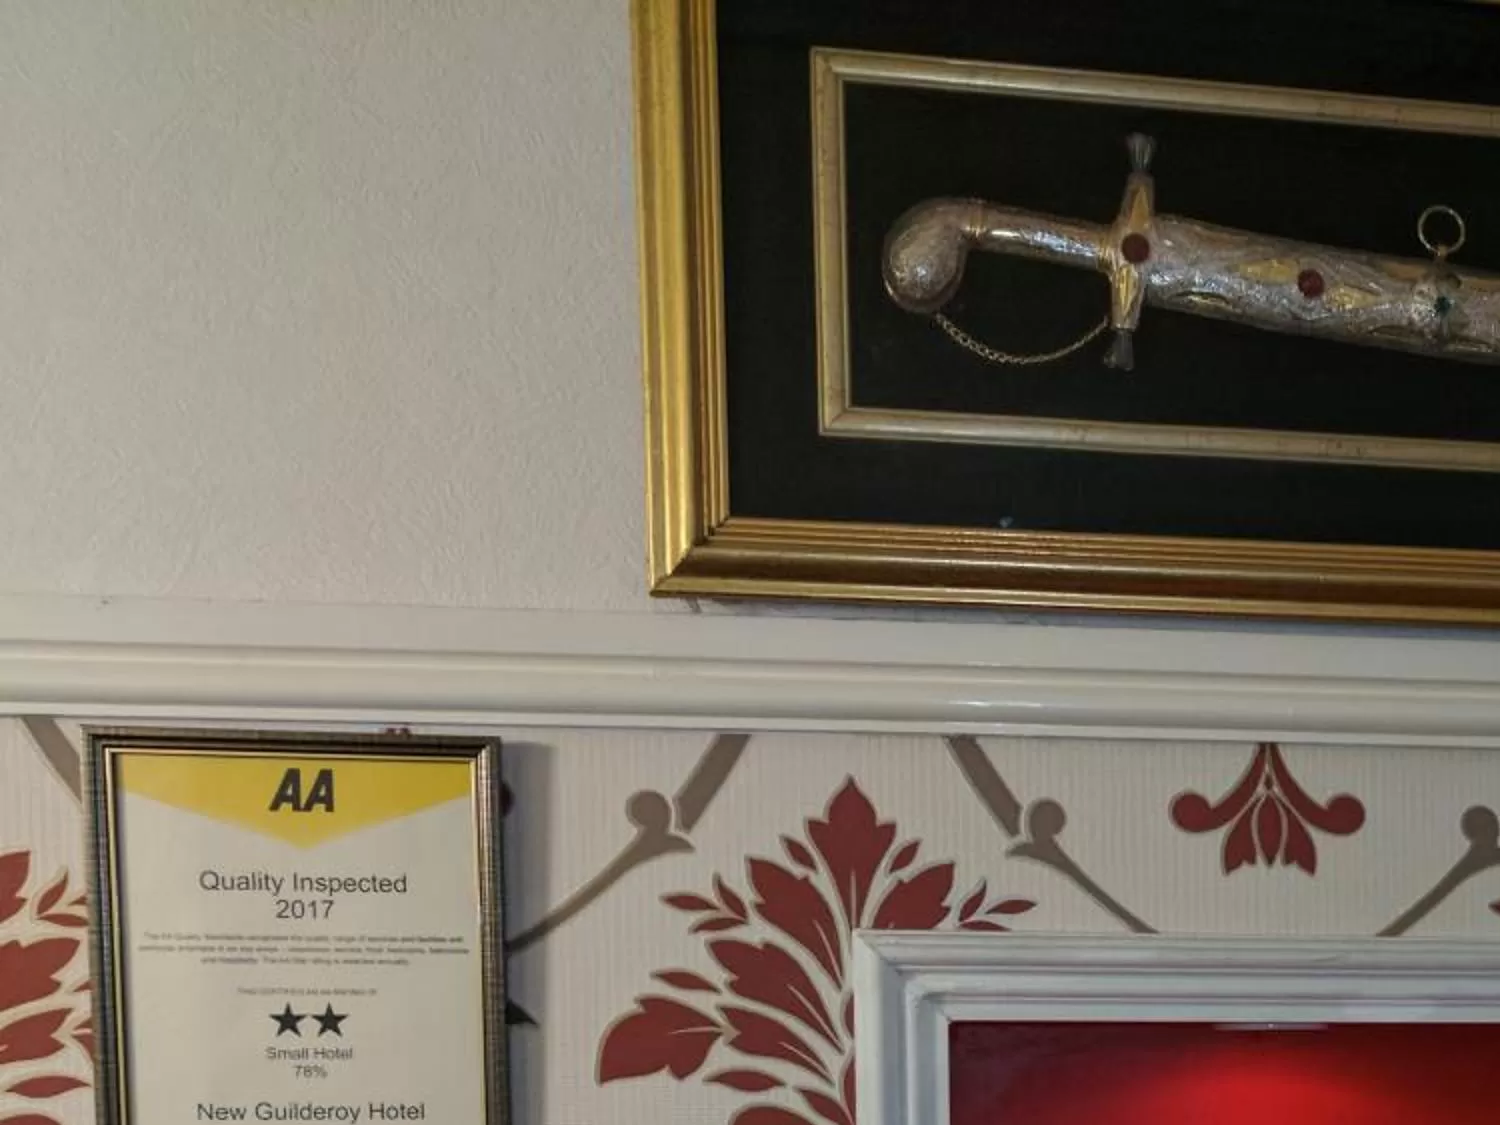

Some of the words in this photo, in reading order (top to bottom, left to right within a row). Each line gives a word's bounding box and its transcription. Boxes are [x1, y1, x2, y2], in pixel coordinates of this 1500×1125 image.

[268, 768, 335, 812] AA
[199, 870, 285, 898] Quality
[293, 872, 409, 898] Inspected
[275, 899, 335, 921] 2017
[264, 1045, 308, 1061] Small
[312, 1045, 354, 1061] Hotel
[196, 1103, 247, 1122] New
[254, 1101, 362, 1125] Guilderoy
[368, 1102, 426, 1122] Hotel
